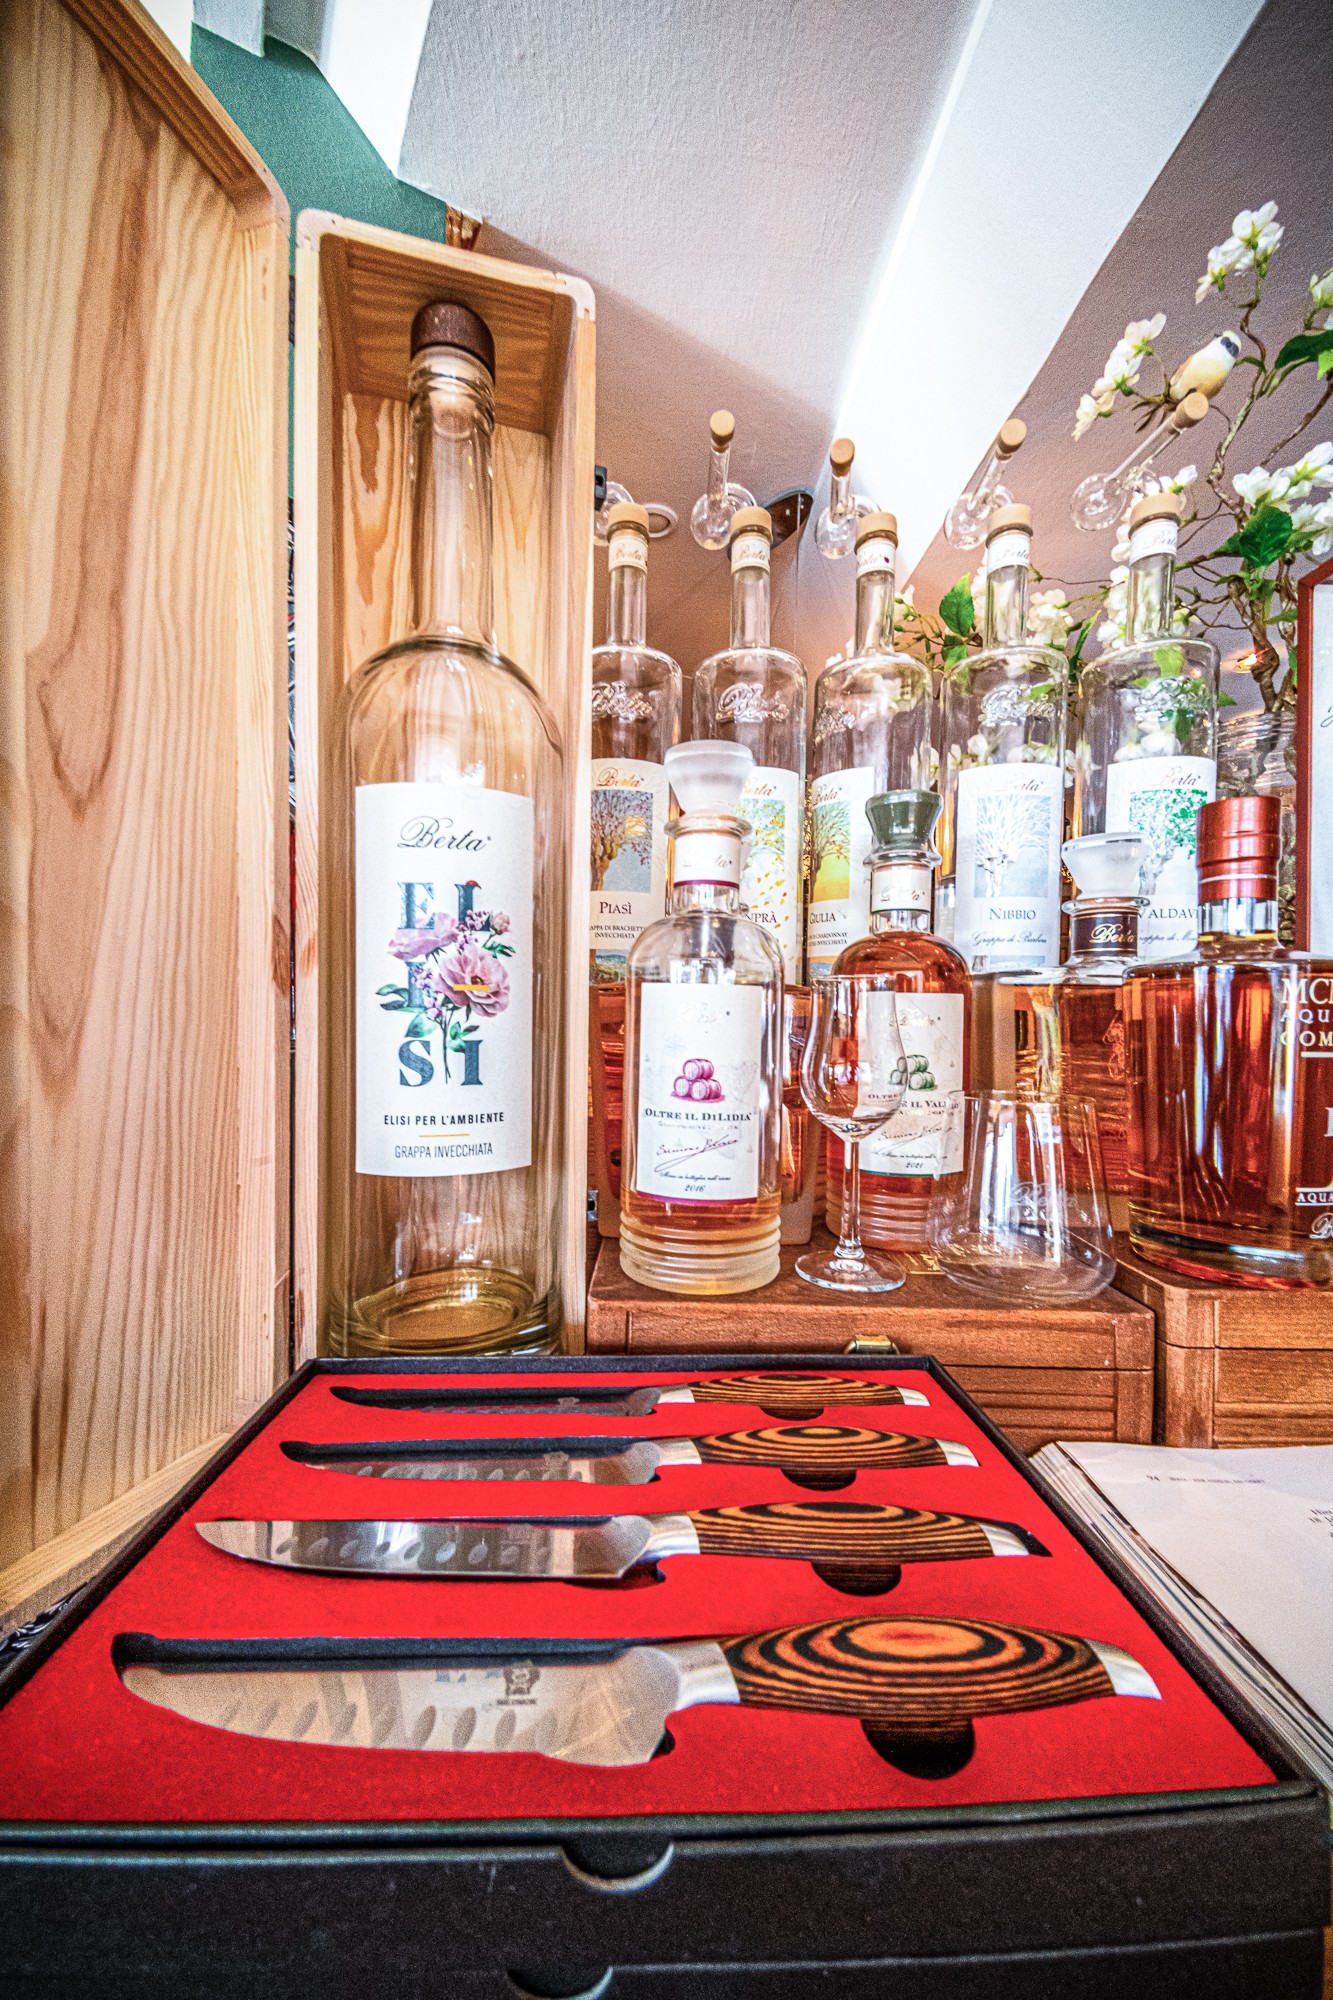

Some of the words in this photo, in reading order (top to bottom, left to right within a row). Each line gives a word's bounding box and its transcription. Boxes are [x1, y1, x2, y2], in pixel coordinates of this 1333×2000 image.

[596, 766, 642, 788] Berta
[397, 815, 487, 851] Berta
[744, 911, 777, 924] NPRÀ
[612, 924, 647, 932] BRACHETT
[1089, 923, 1136, 944] Berta
[594, 931, 636, 939] INVECCHIATA
[1139, 934, 1165, 945] rappa
[384, 1114, 411, 1125] ELISI
[415, 1115, 436, 1125] PER
[441, 1111, 505, 1125] L'AMBIENTE
[645, 1107, 682, 1119] OLTRE
[685, 1112, 699, 1120] IL
[394, 1145, 432, 1158] GRAPPA
[434, 1142, 493, 1158] INVECCHIATA
[684, 1184, 706, 1192] 2016
